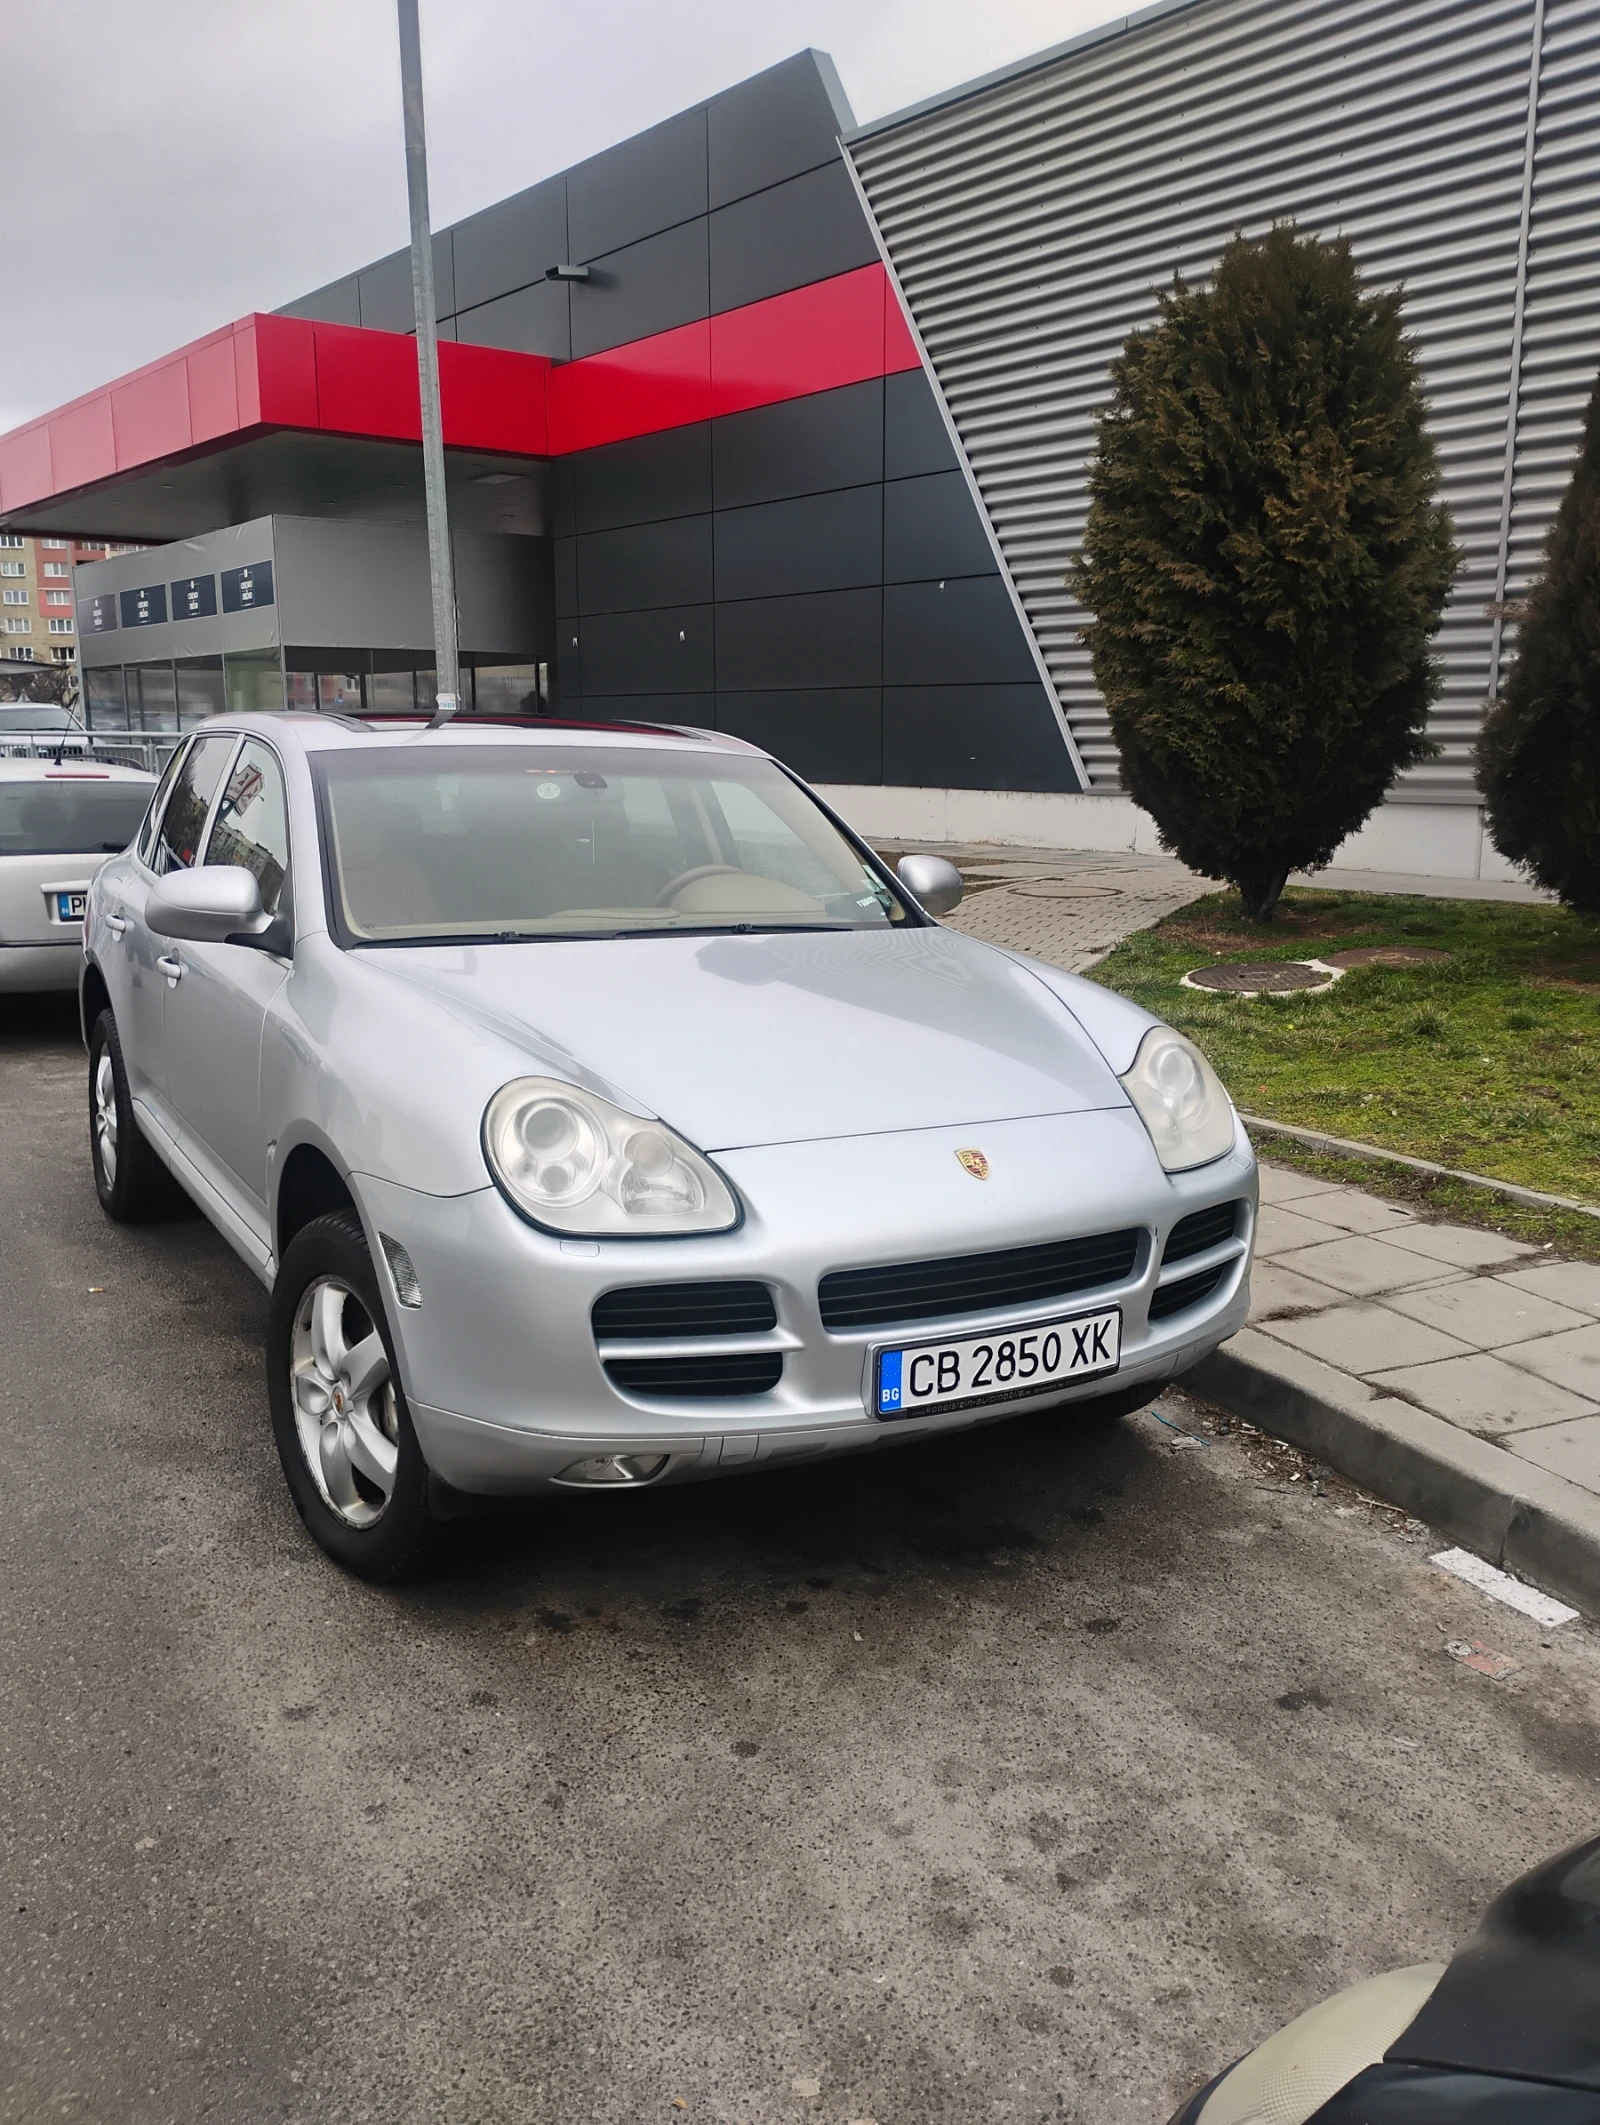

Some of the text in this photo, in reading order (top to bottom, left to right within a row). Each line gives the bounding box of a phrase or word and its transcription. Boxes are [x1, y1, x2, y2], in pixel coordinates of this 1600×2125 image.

[910, 1352, 960, 1396] CB
[971, 1332, 1061, 1387] 2850
[1070, 1320, 1111, 1367] XK
[882, 1388, 900, 1403] BG
